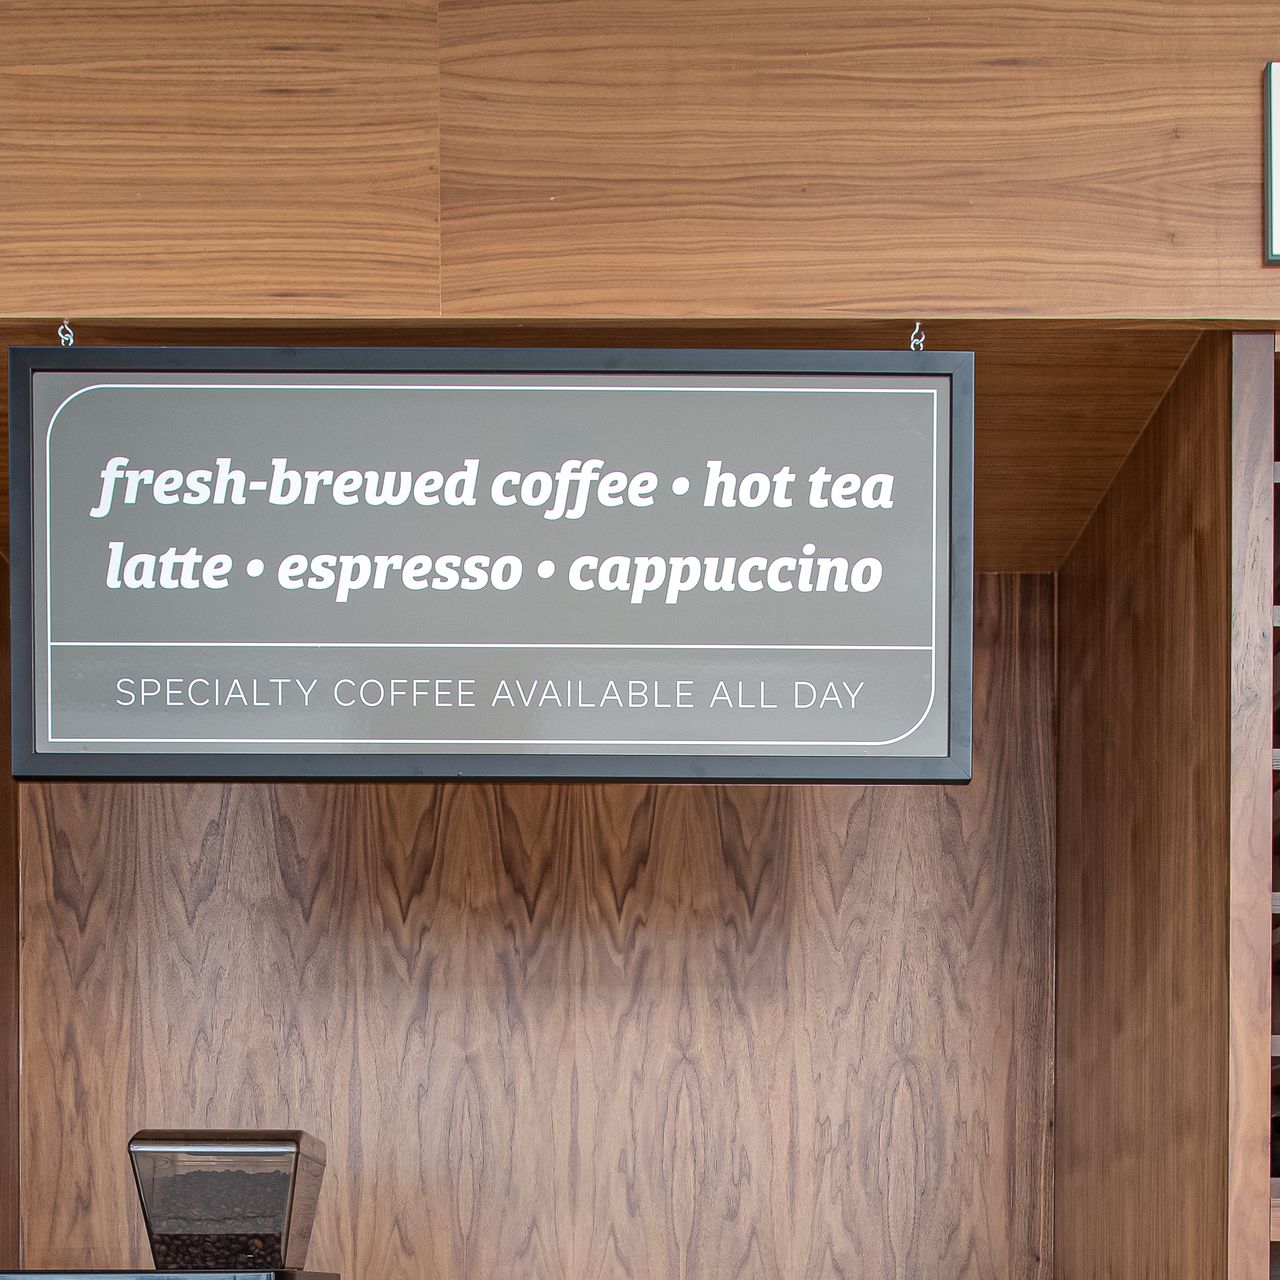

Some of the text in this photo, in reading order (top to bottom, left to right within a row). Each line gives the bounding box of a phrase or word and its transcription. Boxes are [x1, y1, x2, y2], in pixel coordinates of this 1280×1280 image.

[89, 456, 894, 520] fresh-brewed coffee hot tea
[105, 541, 882, 604] latte espresso cappuccino
[116, 678, 865, 709] SPECIALTY COFFEE AVAILABLE ALL DAY
